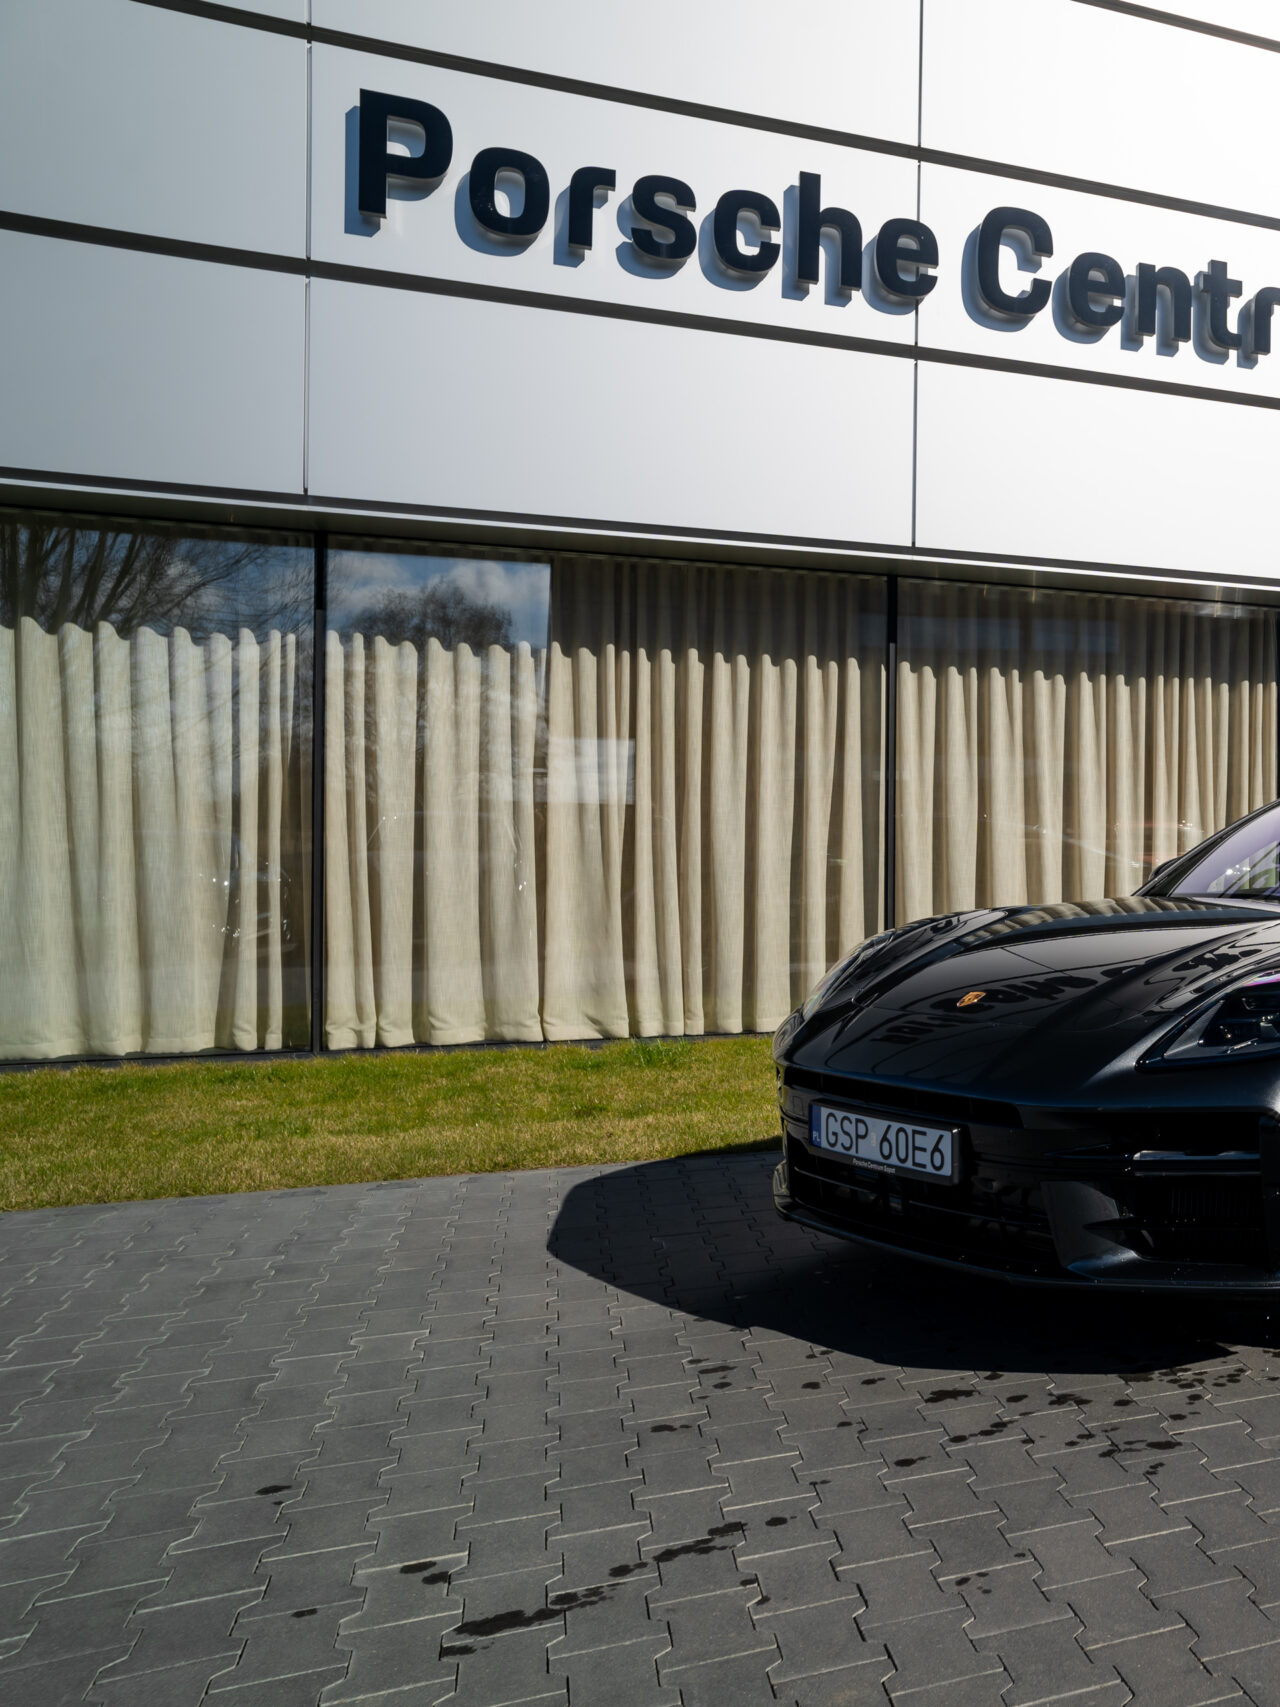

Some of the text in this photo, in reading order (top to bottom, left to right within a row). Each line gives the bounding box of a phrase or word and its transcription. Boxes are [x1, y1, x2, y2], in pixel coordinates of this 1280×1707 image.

[358, 88, 939, 301] Porsche
[812, 1131, 820, 1142] PL
[825, 1112, 945, 1172] GSP 60E6
